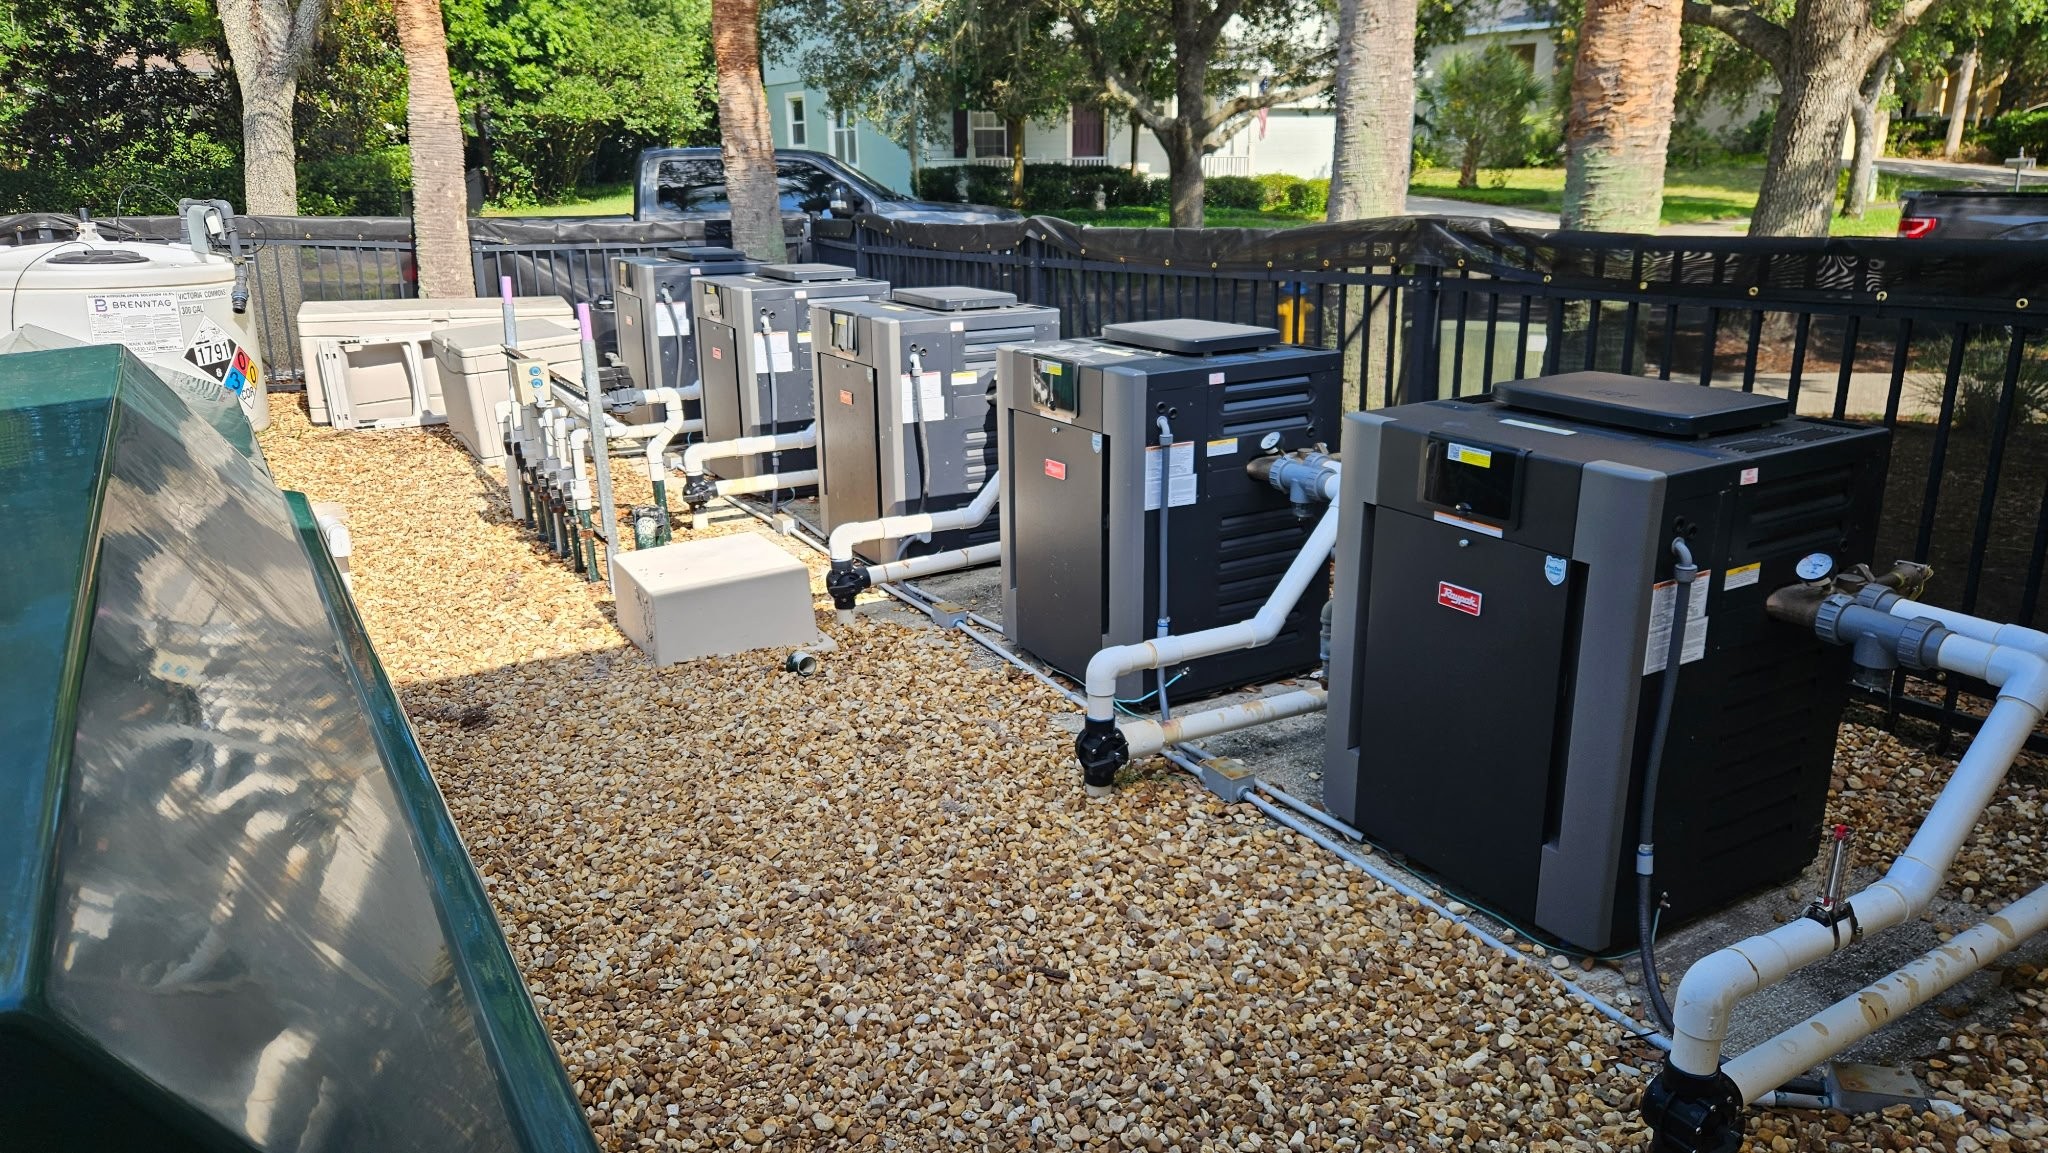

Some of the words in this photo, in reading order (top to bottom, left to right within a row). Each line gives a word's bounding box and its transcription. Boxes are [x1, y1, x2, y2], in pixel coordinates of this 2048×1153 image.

[178, 290, 203, 300] VICTORIA
[204, 288, 226, 298] COMMONS
[112, 299, 172, 309] BRENNTAG
[181, 306, 192, 315] 300
[192, 305, 204, 314] GAL
[198, 341, 230, 365] 1791
[237, 351, 246, 371] 0
[215, 367, 223, 378] 8
[230, 371, 240, 390] 3
[249, 365, 257, 384] 0
[241, 386, 255, 400] COR
[1440, 587, 1478, 607] Raypak
